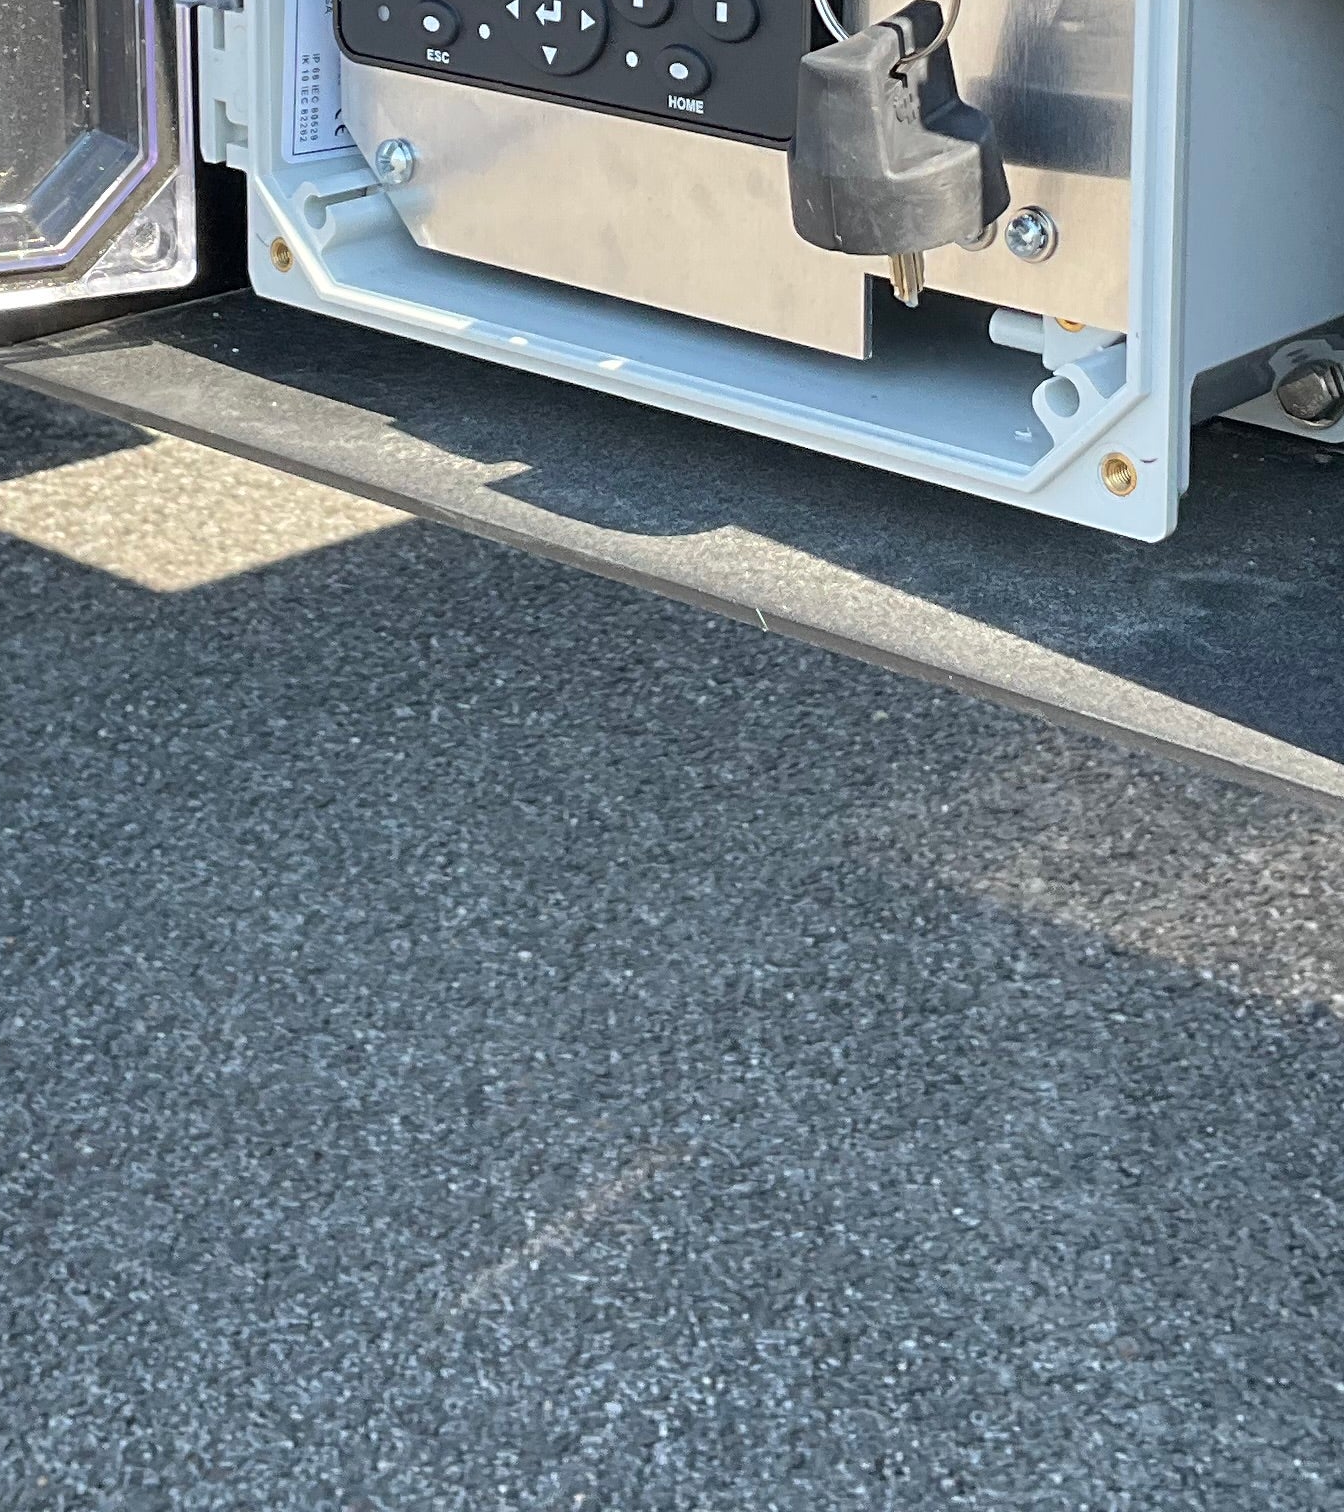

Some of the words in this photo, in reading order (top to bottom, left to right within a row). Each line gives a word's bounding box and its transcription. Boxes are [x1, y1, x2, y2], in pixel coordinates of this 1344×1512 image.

[301, 54, 310, 65] IK
[312, 53, 321, 64] IP
[426, 48, 450, 64] ESC
[301, 69, 309, 82] 10
[300, 86, 309, 105] IEC
[311, 84, 320, 104] IEC
[667, 94, 705, 114] HOME
